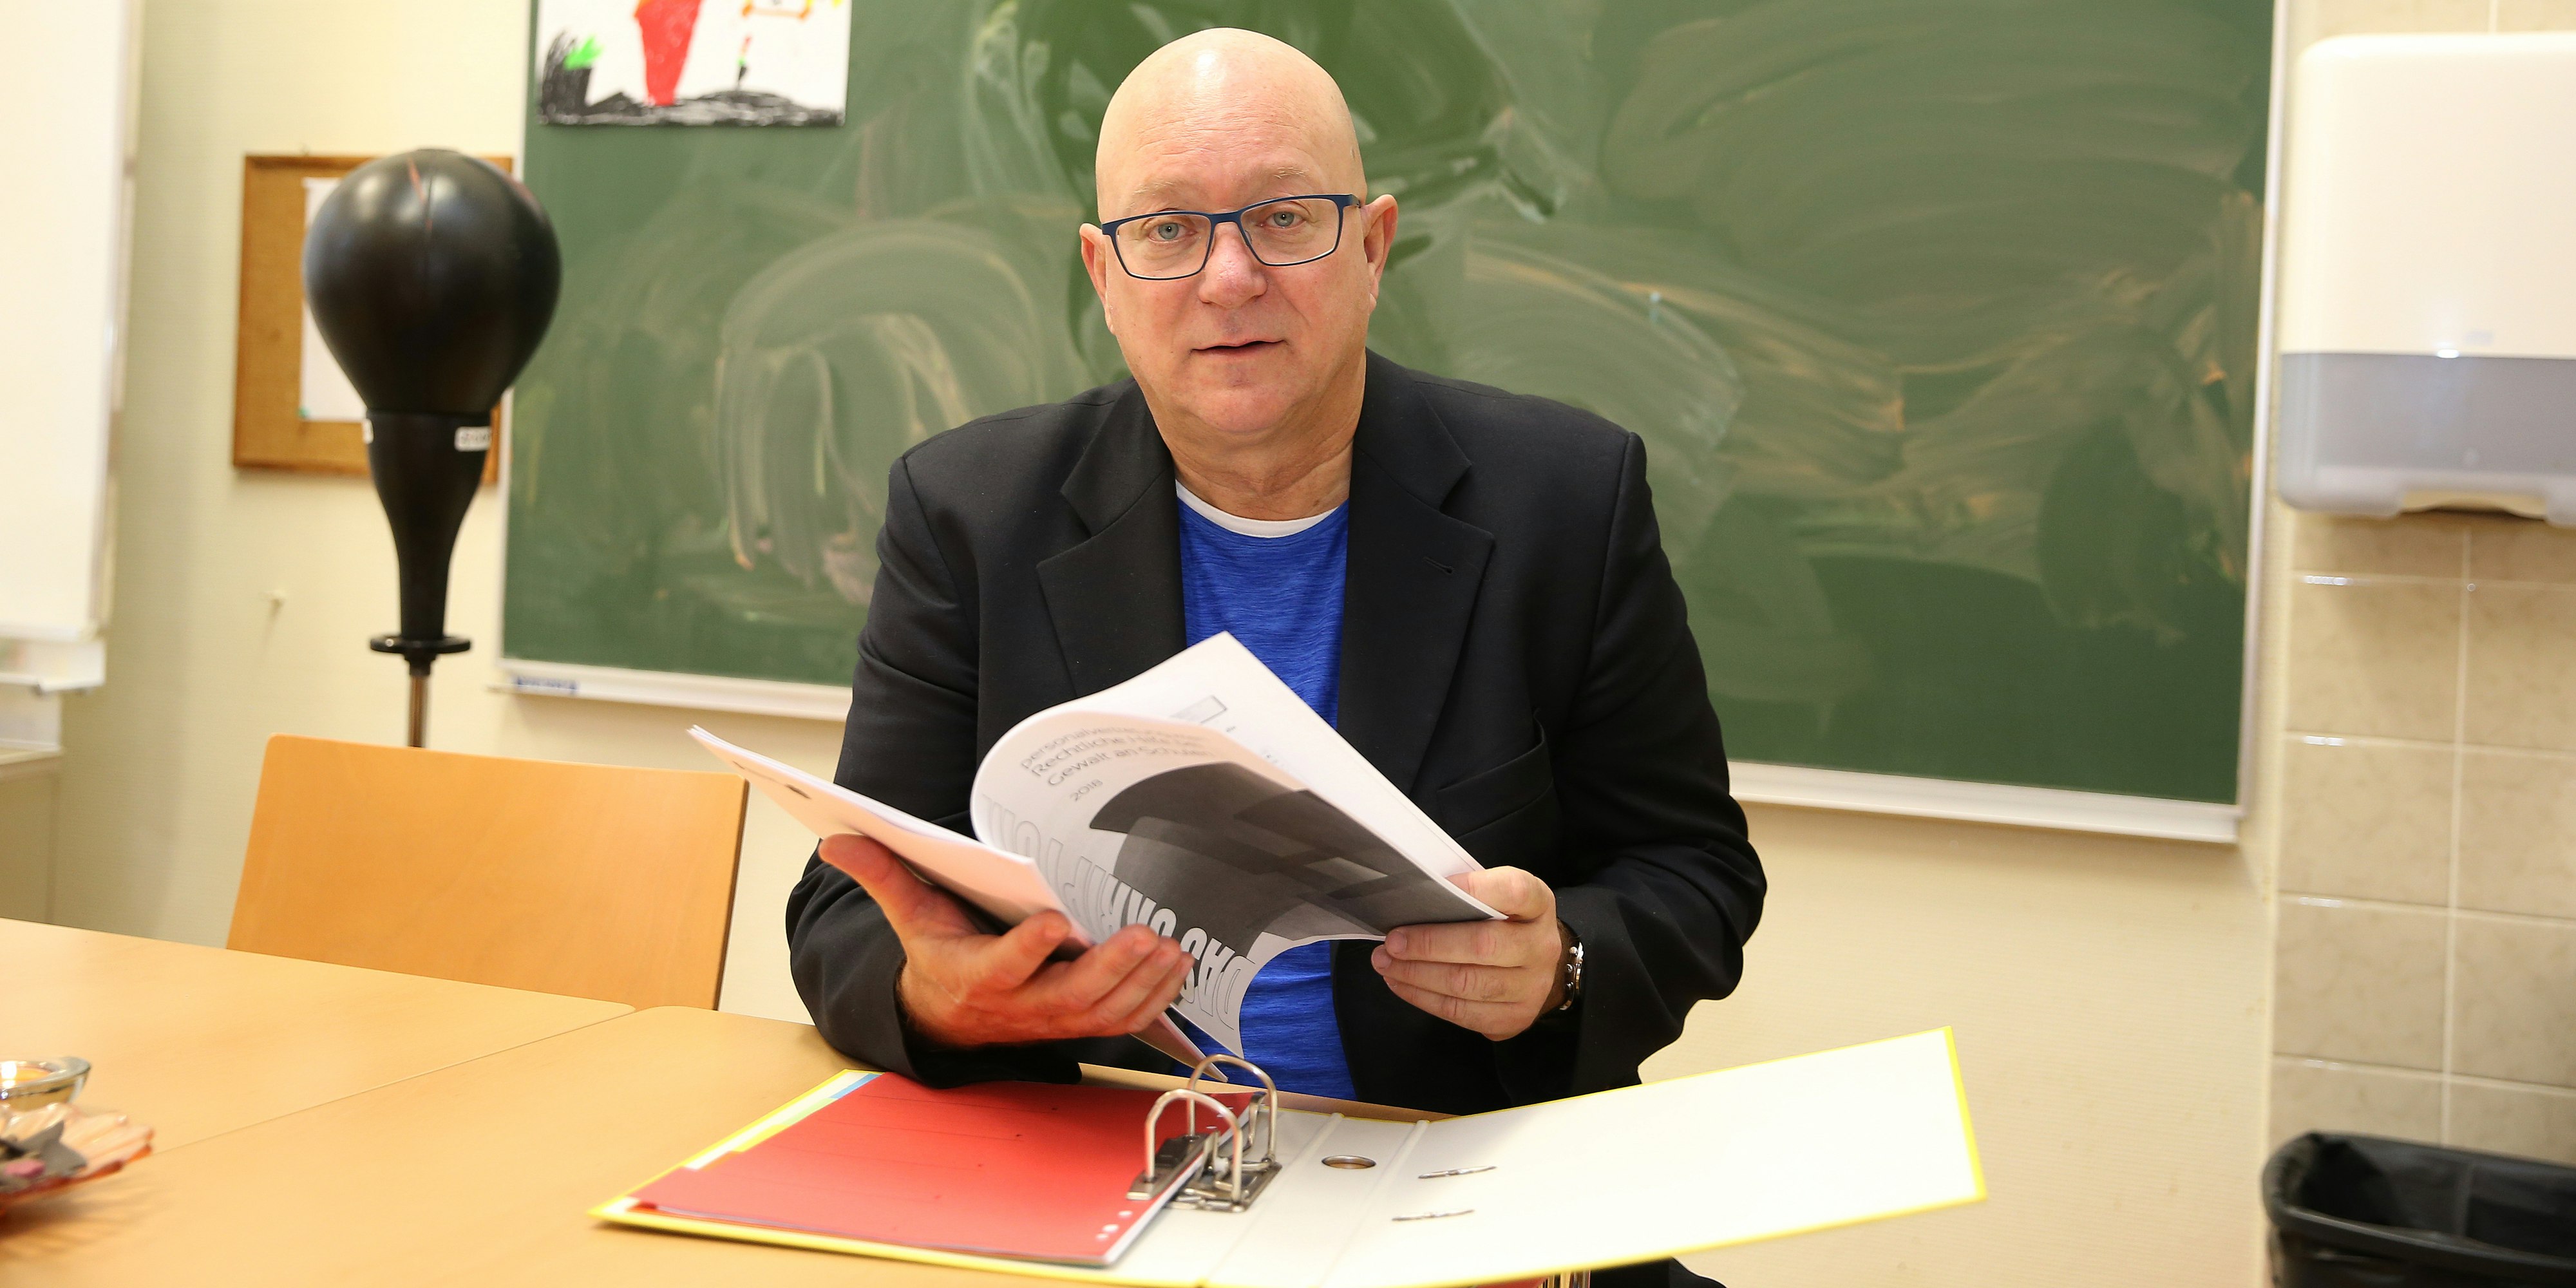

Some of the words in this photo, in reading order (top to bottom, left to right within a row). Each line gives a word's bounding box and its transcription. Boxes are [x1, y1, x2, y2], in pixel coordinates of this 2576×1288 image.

[1031, 735, 1126, 777] Rechtliche
[1047, 750, 1112, 786] Gewalt
[1115, 747, 1139, 758] an
[1069, 778, 1103, 802] 2018
[1180, 927, 1255, 1030] DAS
